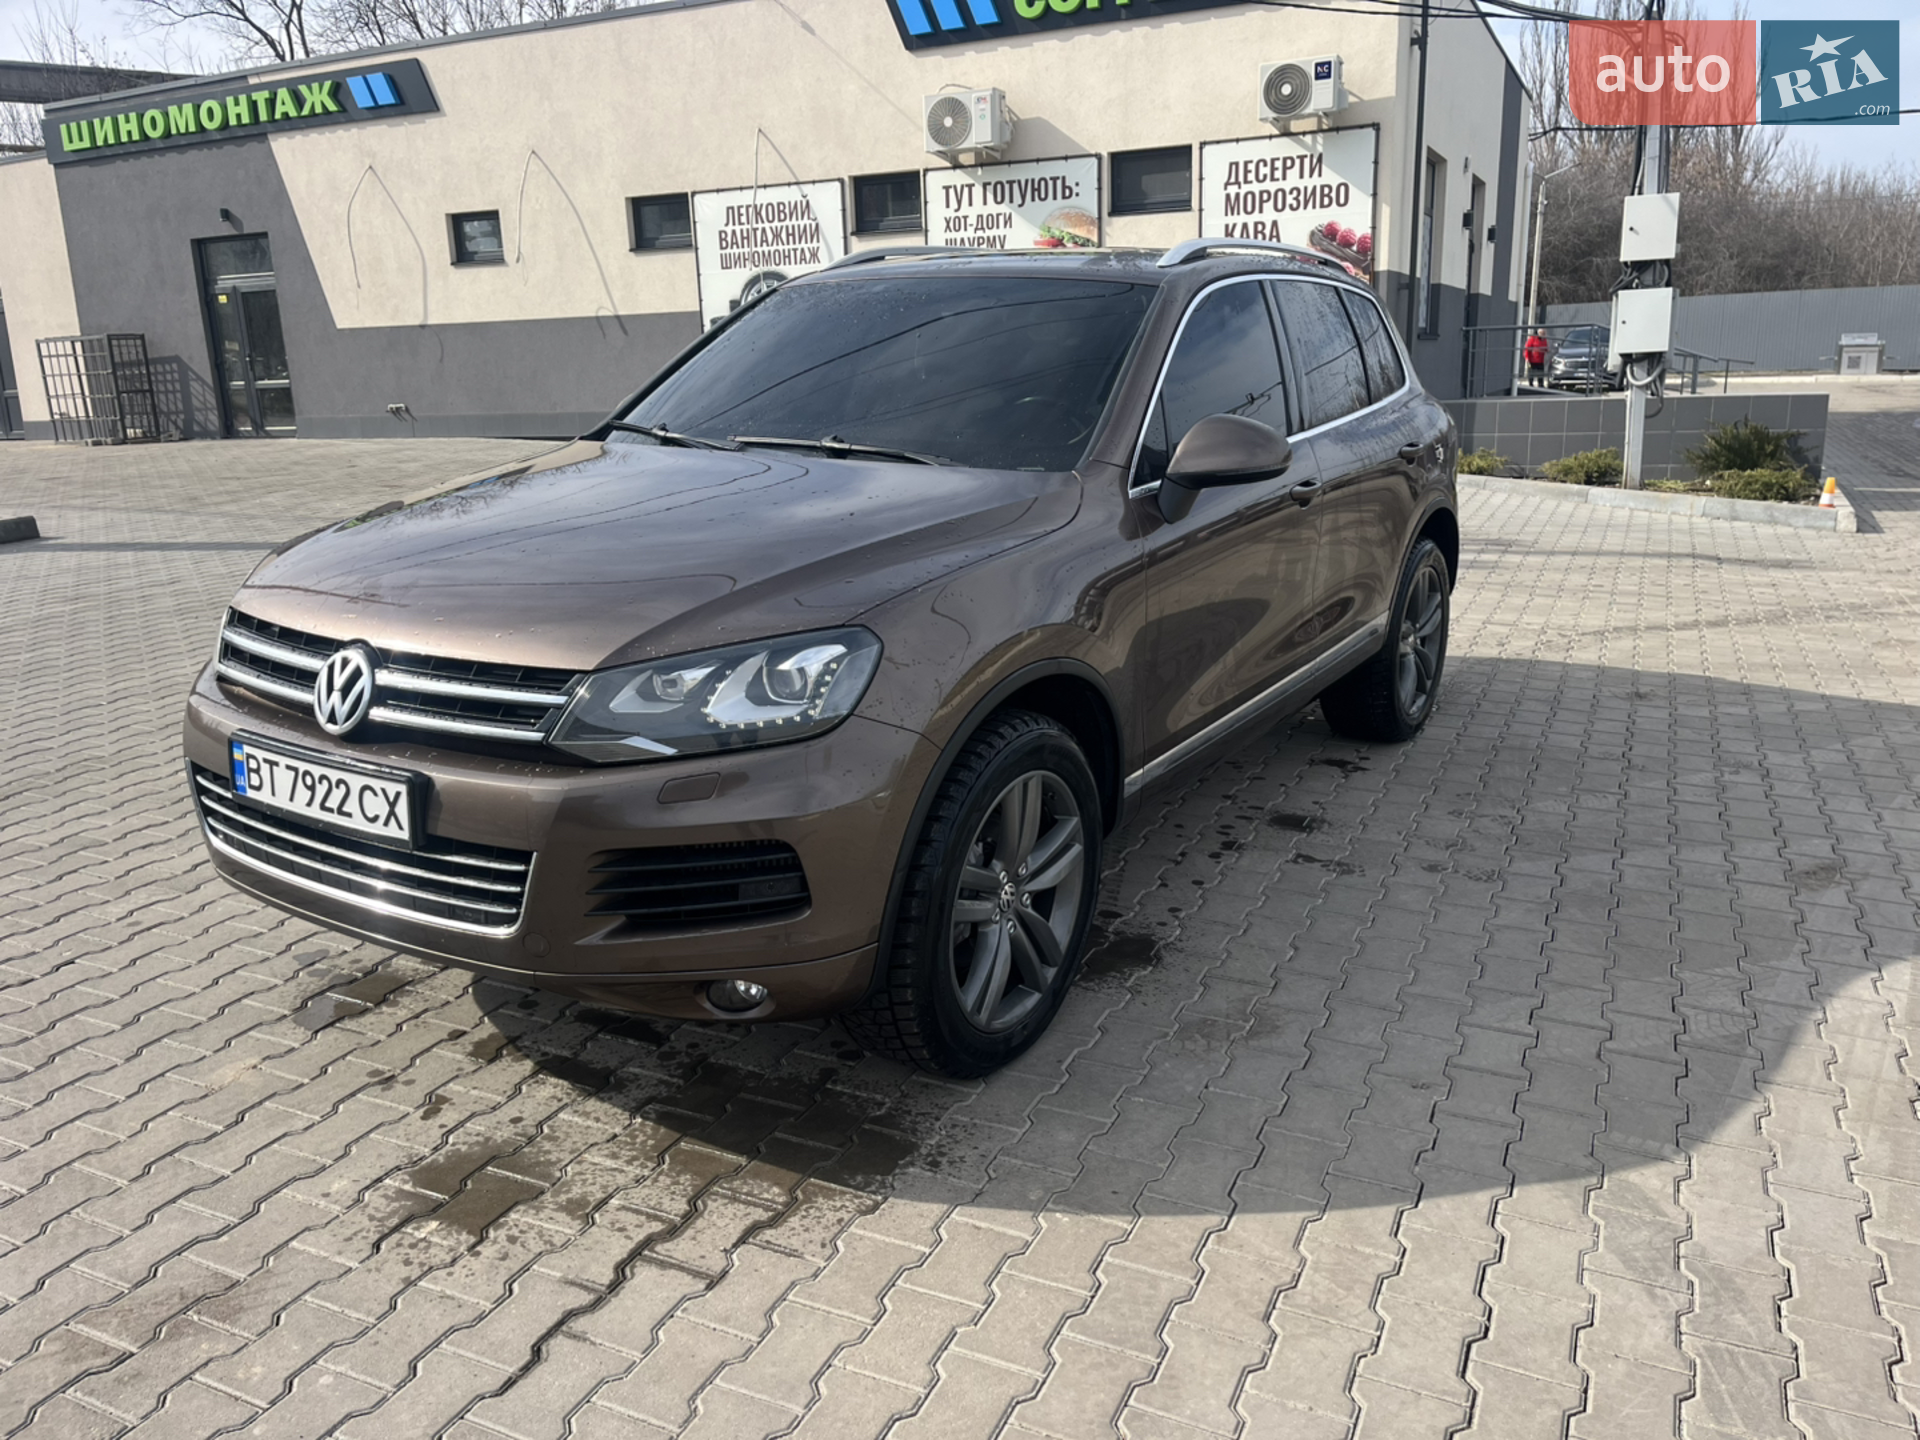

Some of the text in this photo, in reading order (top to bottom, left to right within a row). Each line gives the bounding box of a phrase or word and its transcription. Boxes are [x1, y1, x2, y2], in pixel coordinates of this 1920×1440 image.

[59, 80, 340, 152] ШИНОМОНТАЖ
[1223, 152, 1324, 191] ДЕСЕРТИ
[724, 194, 812, 227] ЛЕГКОВИЙ
[942, 175, 1080, 213] ТУТ ГОТУЮТЬ:
[1224, 182, 1350, 217] МОРОЗИВО
[718, 217, 821, 251] ВАНТАЖНИЙ
[943, 212, 1013, 234] ХОТ-ДОГИ
[1224, 219, 1282, 243] КАВА
[719, 246, 821, 270] ШИНОМОНТАЖ
[245, 751, 405, 832] BT 7922 CX
